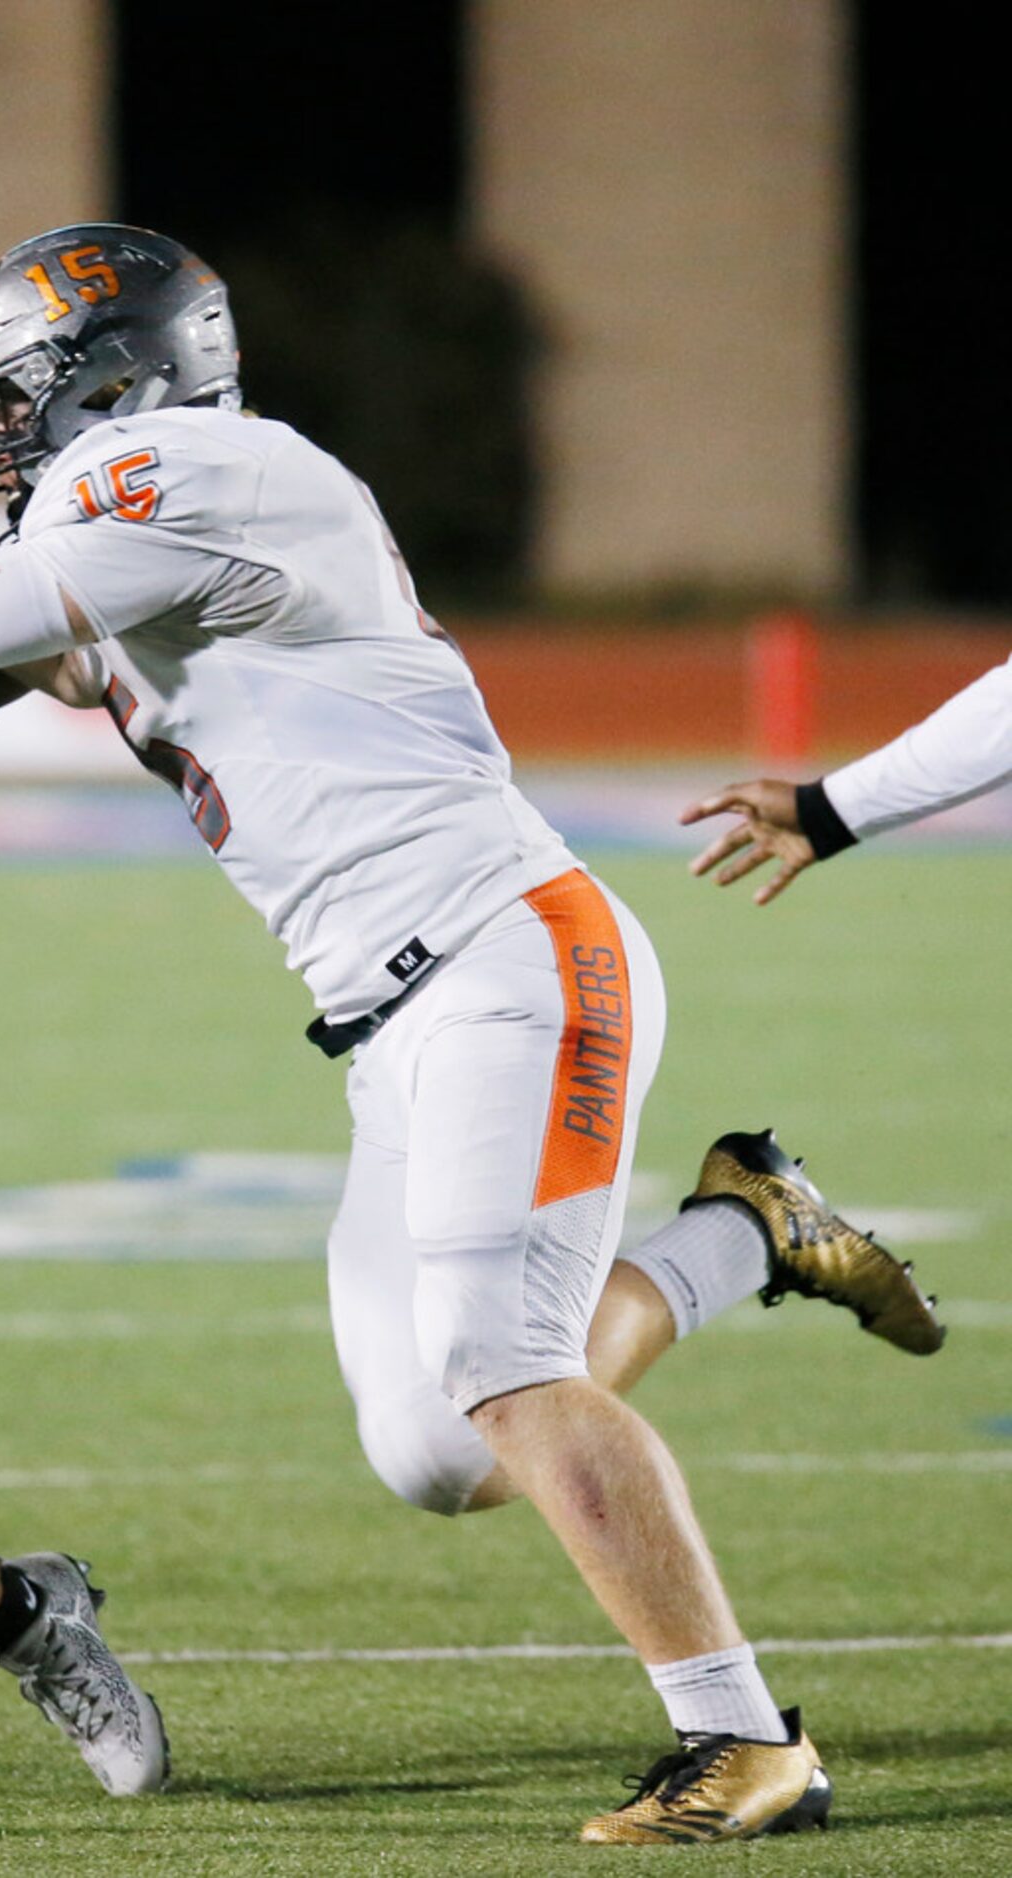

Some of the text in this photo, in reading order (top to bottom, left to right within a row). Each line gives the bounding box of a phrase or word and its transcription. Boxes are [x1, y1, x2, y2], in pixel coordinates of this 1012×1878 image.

[23, 245, 121, 324] 15
[68, 445, 164, 523] 15
[563, 944, 624, 1145] PANTHERS
